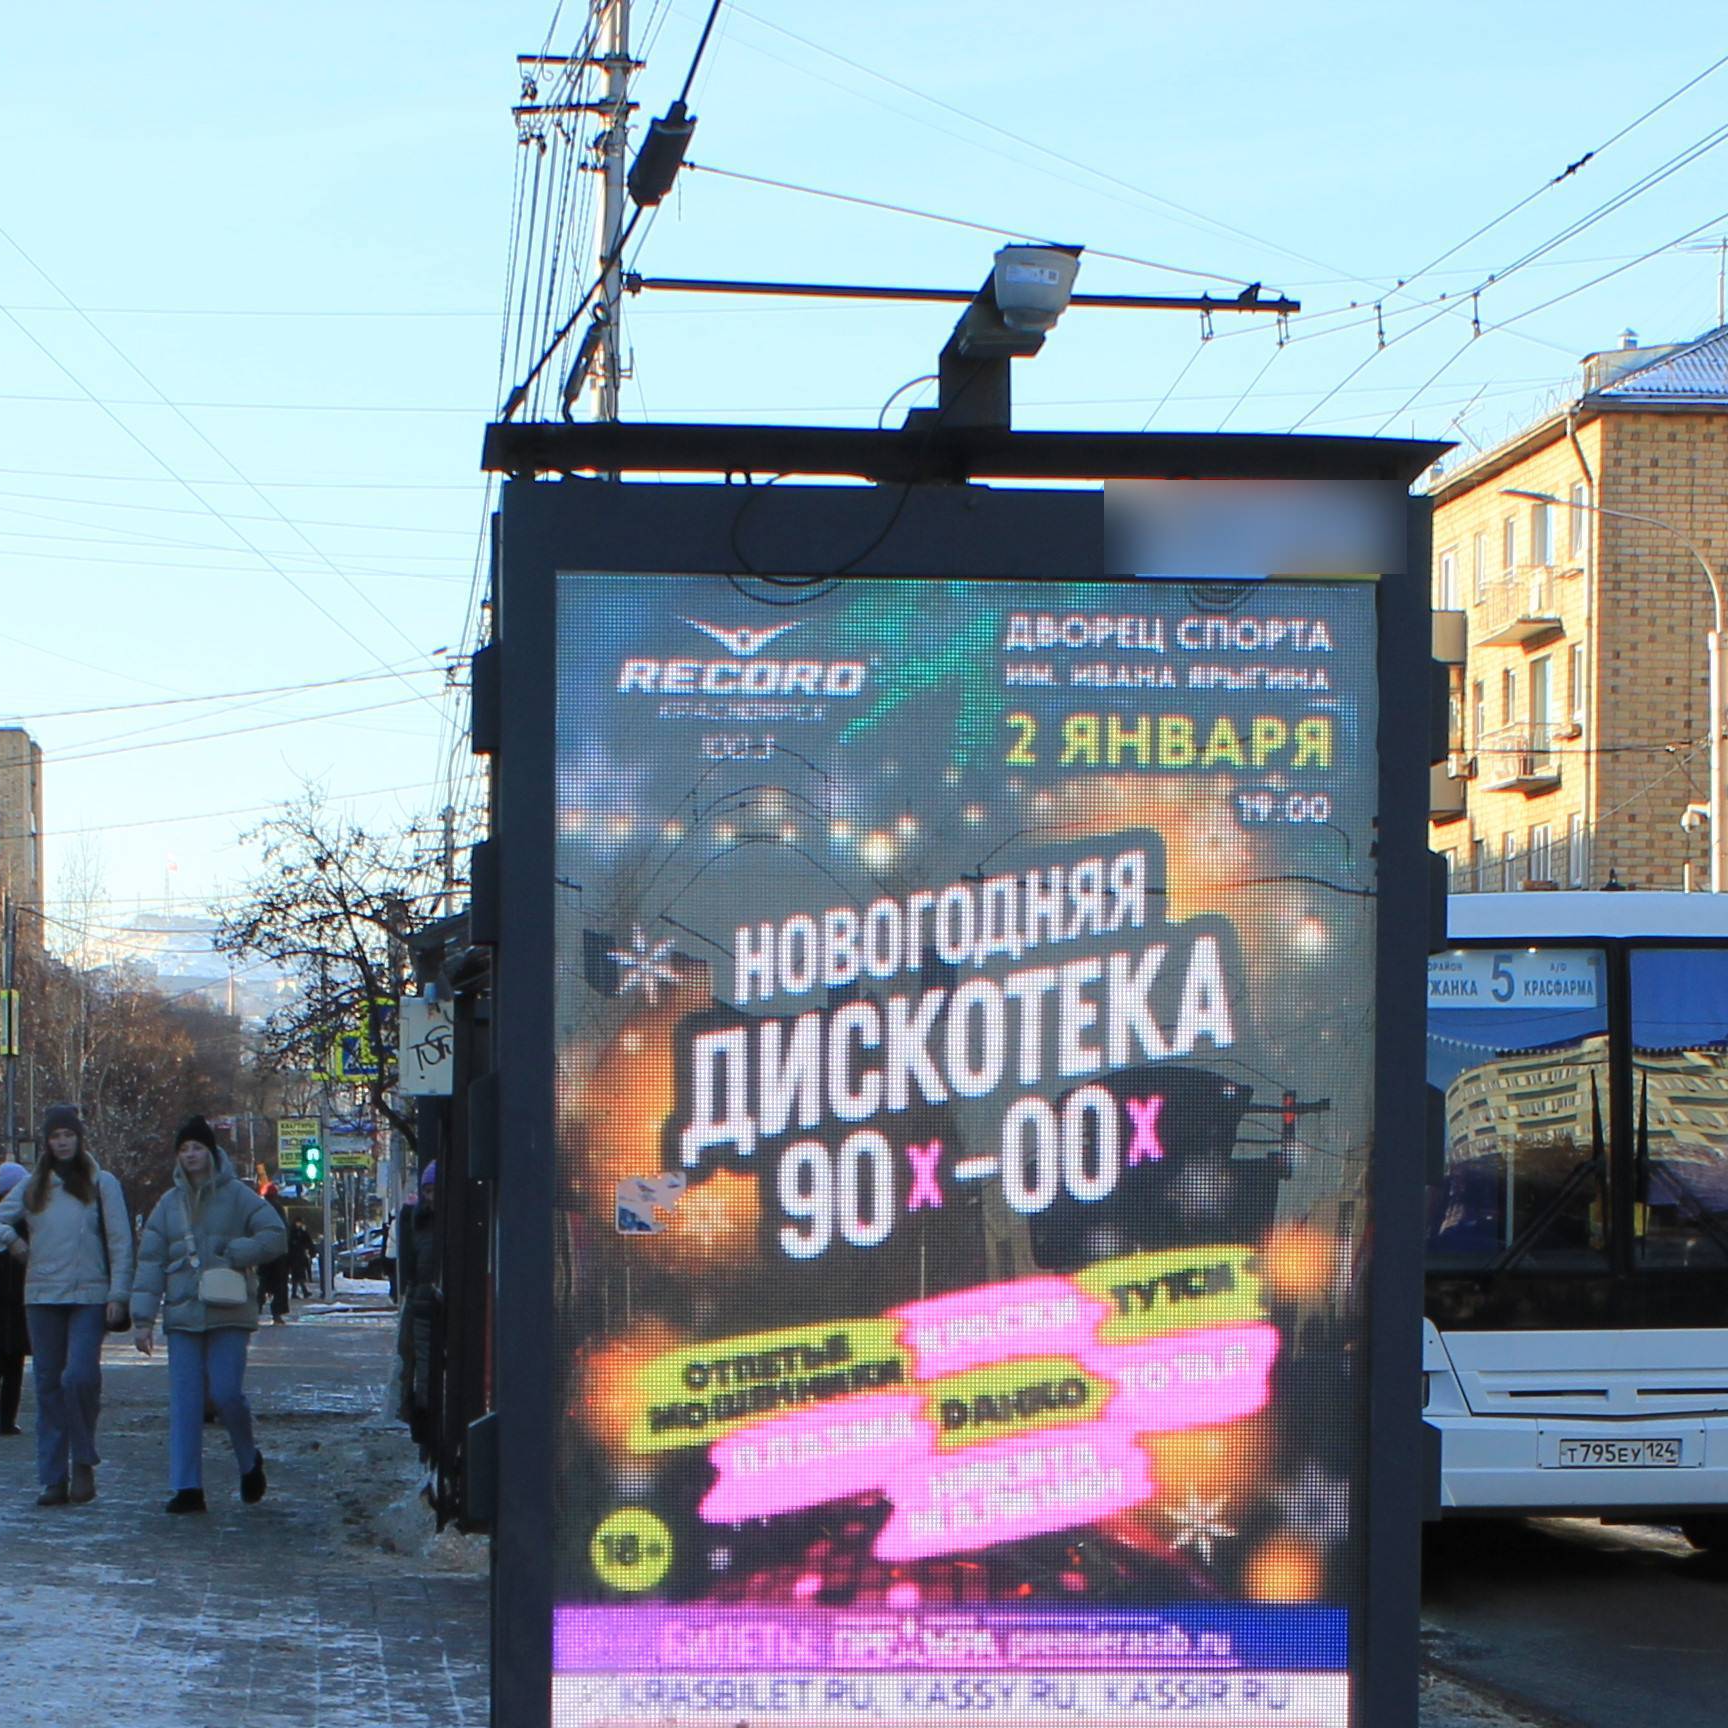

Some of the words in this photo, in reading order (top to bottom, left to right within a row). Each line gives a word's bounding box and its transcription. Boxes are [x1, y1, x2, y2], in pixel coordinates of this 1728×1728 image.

[1003, 613, 1165, 653] ДВОРЕЦ
[1176, 616, 1333, 652] СПОРТА
[617, 659, 866, 696] RECORD
[1070, 663, 1176, 688] ИВАНА
[1186, 664, 1330, 690] ЯРЫГИНА
[1005, 711, 1036, 767] 2
[1057, 713, 1332, 769] ЯНВАРЯ
[1238, 793, 1332, 823] 19:00
[734, 849, 1147, 1005] НОВОГОДНЯЯ
[1428, 979, 1478, 997] ЖАНКА
[1490, 954, 1515, 1003] 5
[1523, 979, 1594, 997] КРАСФАРМА
[681, 935, 1234, 1168] ДИСКОТЕКА
[684, 1333, 850, 1389] ОТПЕТЫЕ
[649, 1358, 903, 1433] МОШЕННИКИ
[1646, 1442, 1675, 1459] 124
[598, 1531, 665, 1567] 18+
